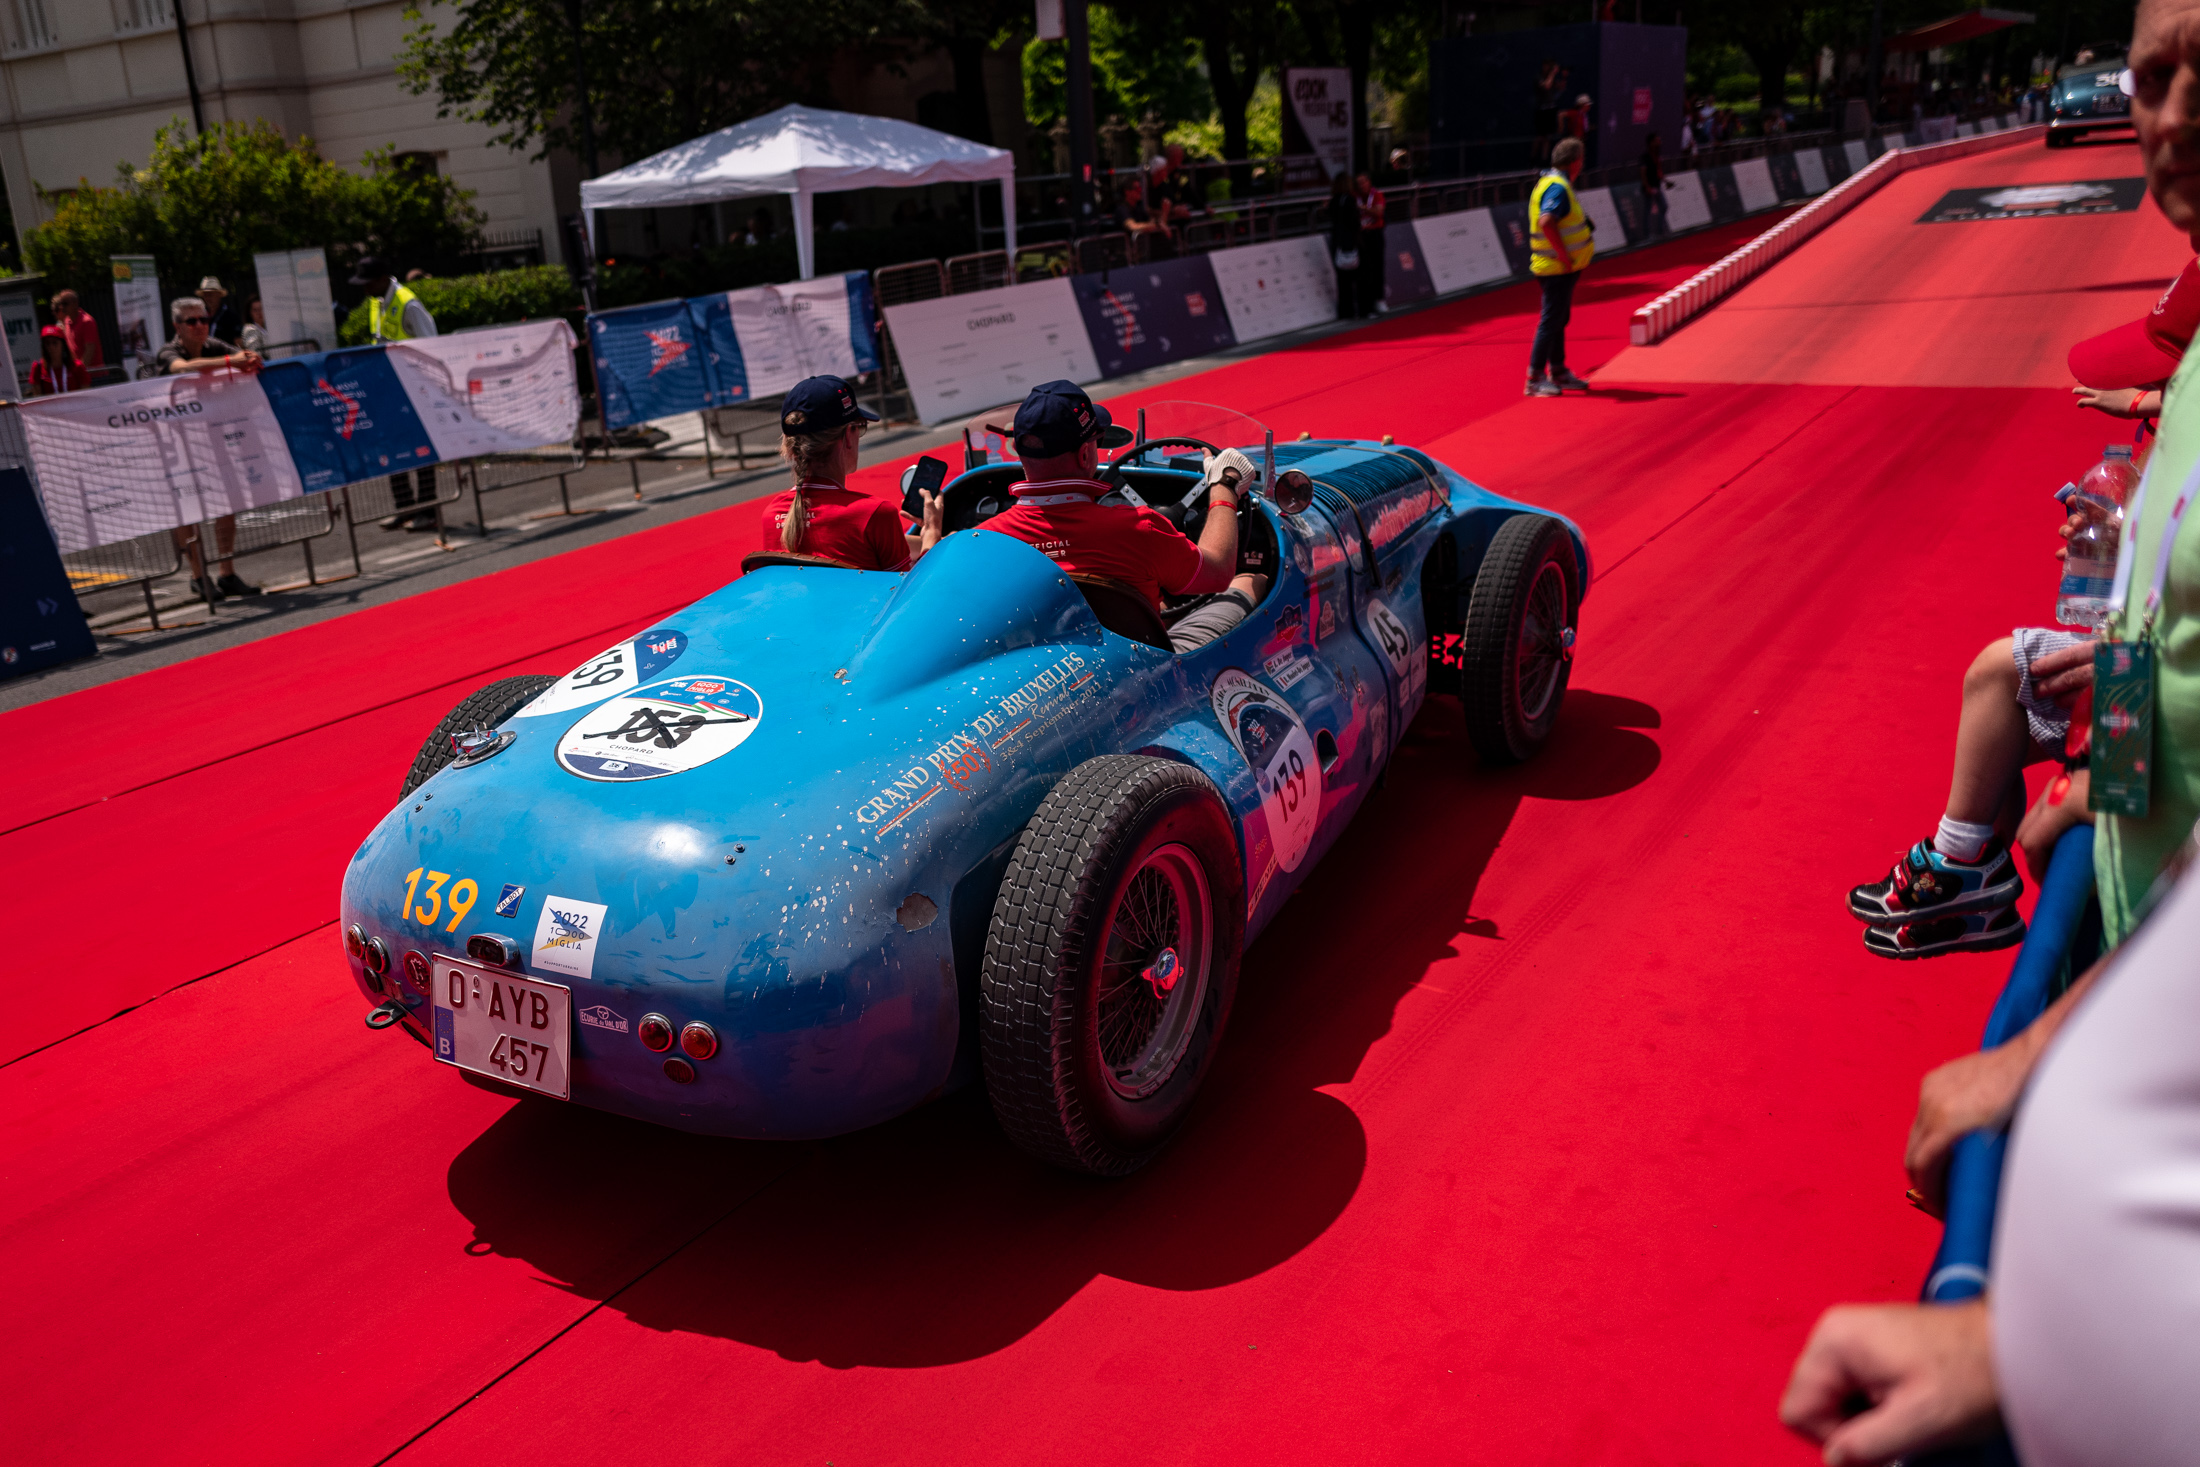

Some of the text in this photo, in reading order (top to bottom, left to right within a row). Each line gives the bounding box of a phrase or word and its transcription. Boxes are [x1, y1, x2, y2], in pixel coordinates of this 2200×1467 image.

[967, 312, 1016, 330] CHOPARD
[108, 402, 203, 428] CHOPARD
[1374, 610, 1408, 662] 45
[572, 649, 624, 690] 139
[1000, 681, 1103, 762] 3&4 September 2011
[609, 744, 654, 755] CHOPARD
[857, 651, 1085, 823] GRAND PRIX DE BRUXELLES
[951, 753, 980, 780] 50
[1273, 749, 1307, 823] 139
[1986, 853, 2006, 874] GEOX
[402, 867, 479, 933] 139
[497, 888, 521, 910] TALBOT
[552, 910, 589, 929] 2022
[546, 937, 582, 950] MIGLIA
[550, 927, 585, 940] 1000
[440, 1037, 451, 1055] B
[489, 1033, 550, 1082] 457
